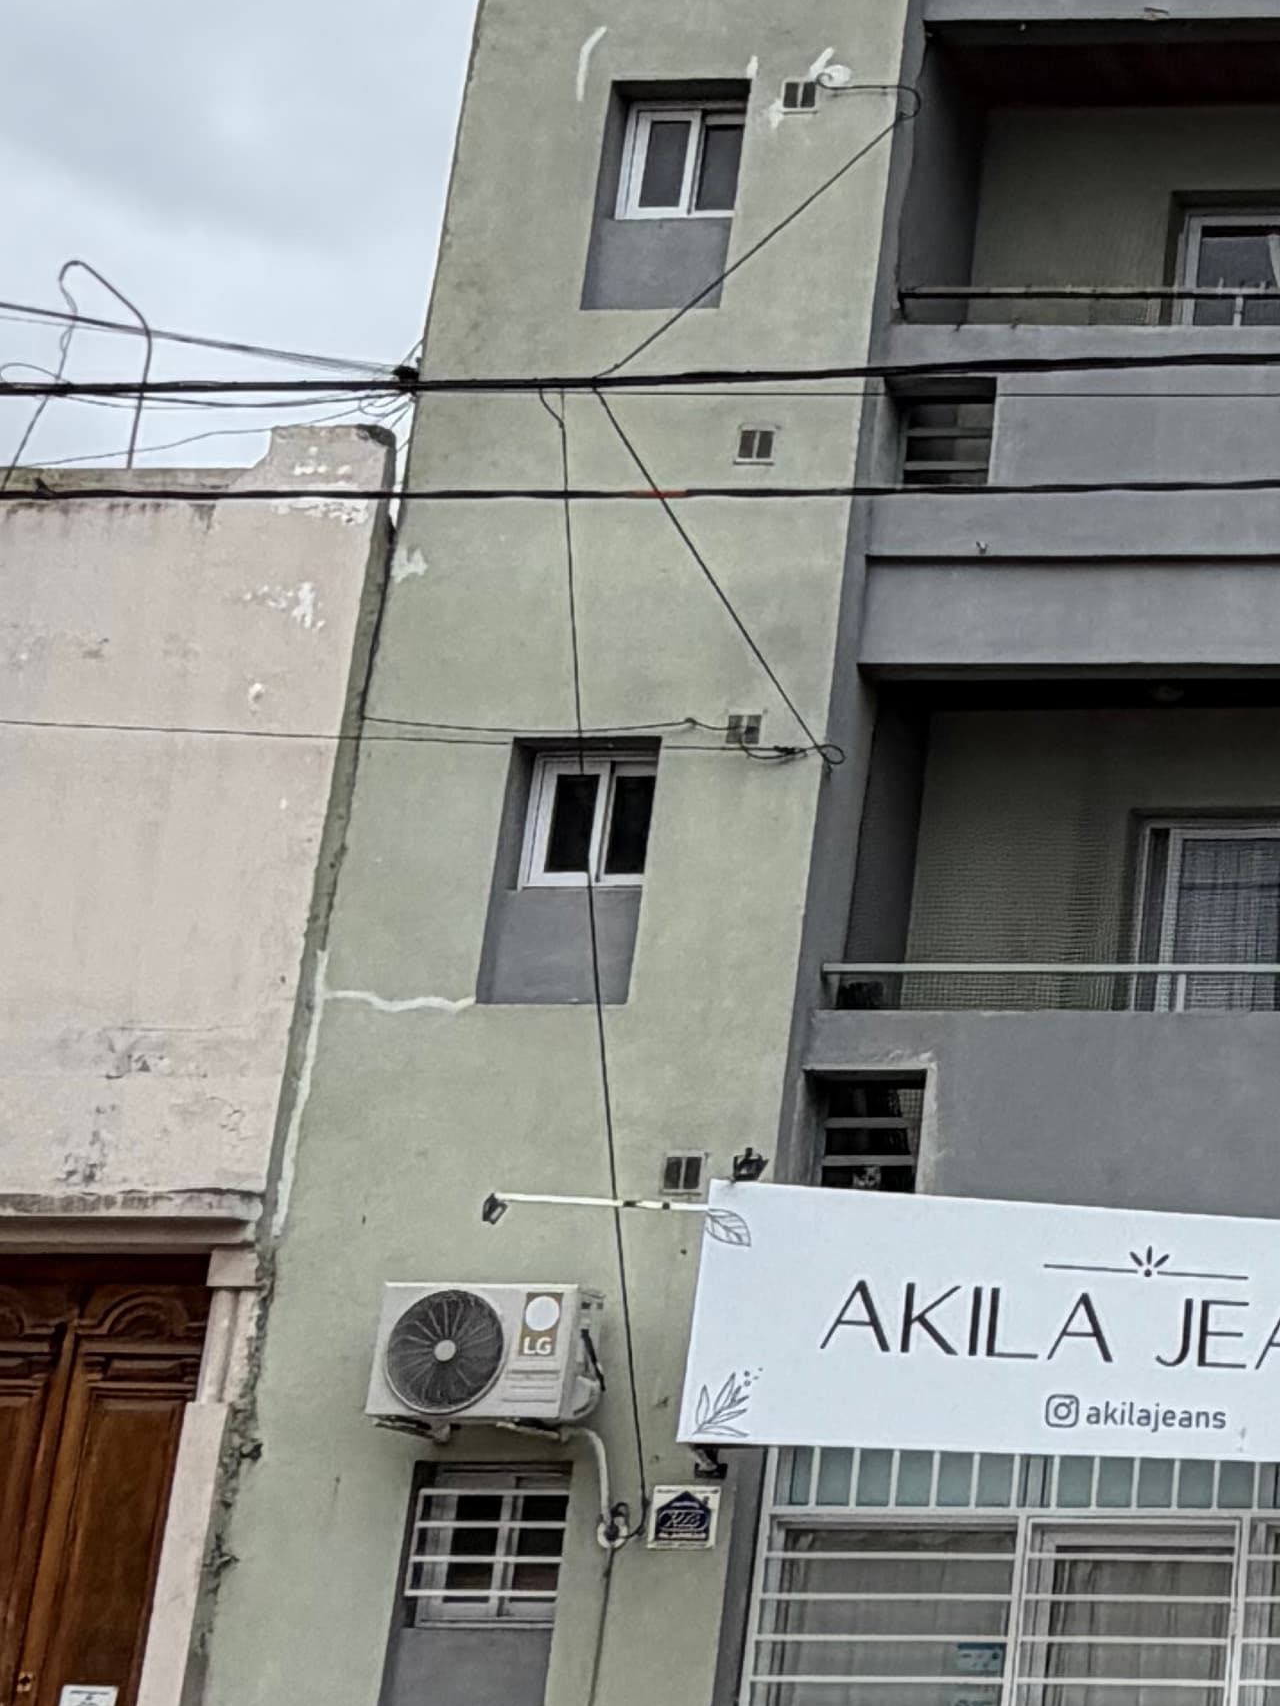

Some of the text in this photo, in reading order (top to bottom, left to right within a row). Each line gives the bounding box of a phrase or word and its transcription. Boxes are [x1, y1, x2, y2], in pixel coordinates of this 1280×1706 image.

[819, 1279, 1114, 1363] AKILA
[523, 1336, 553, 1355] LG
[1085, 1400, 1228, 1434] akilajeans
